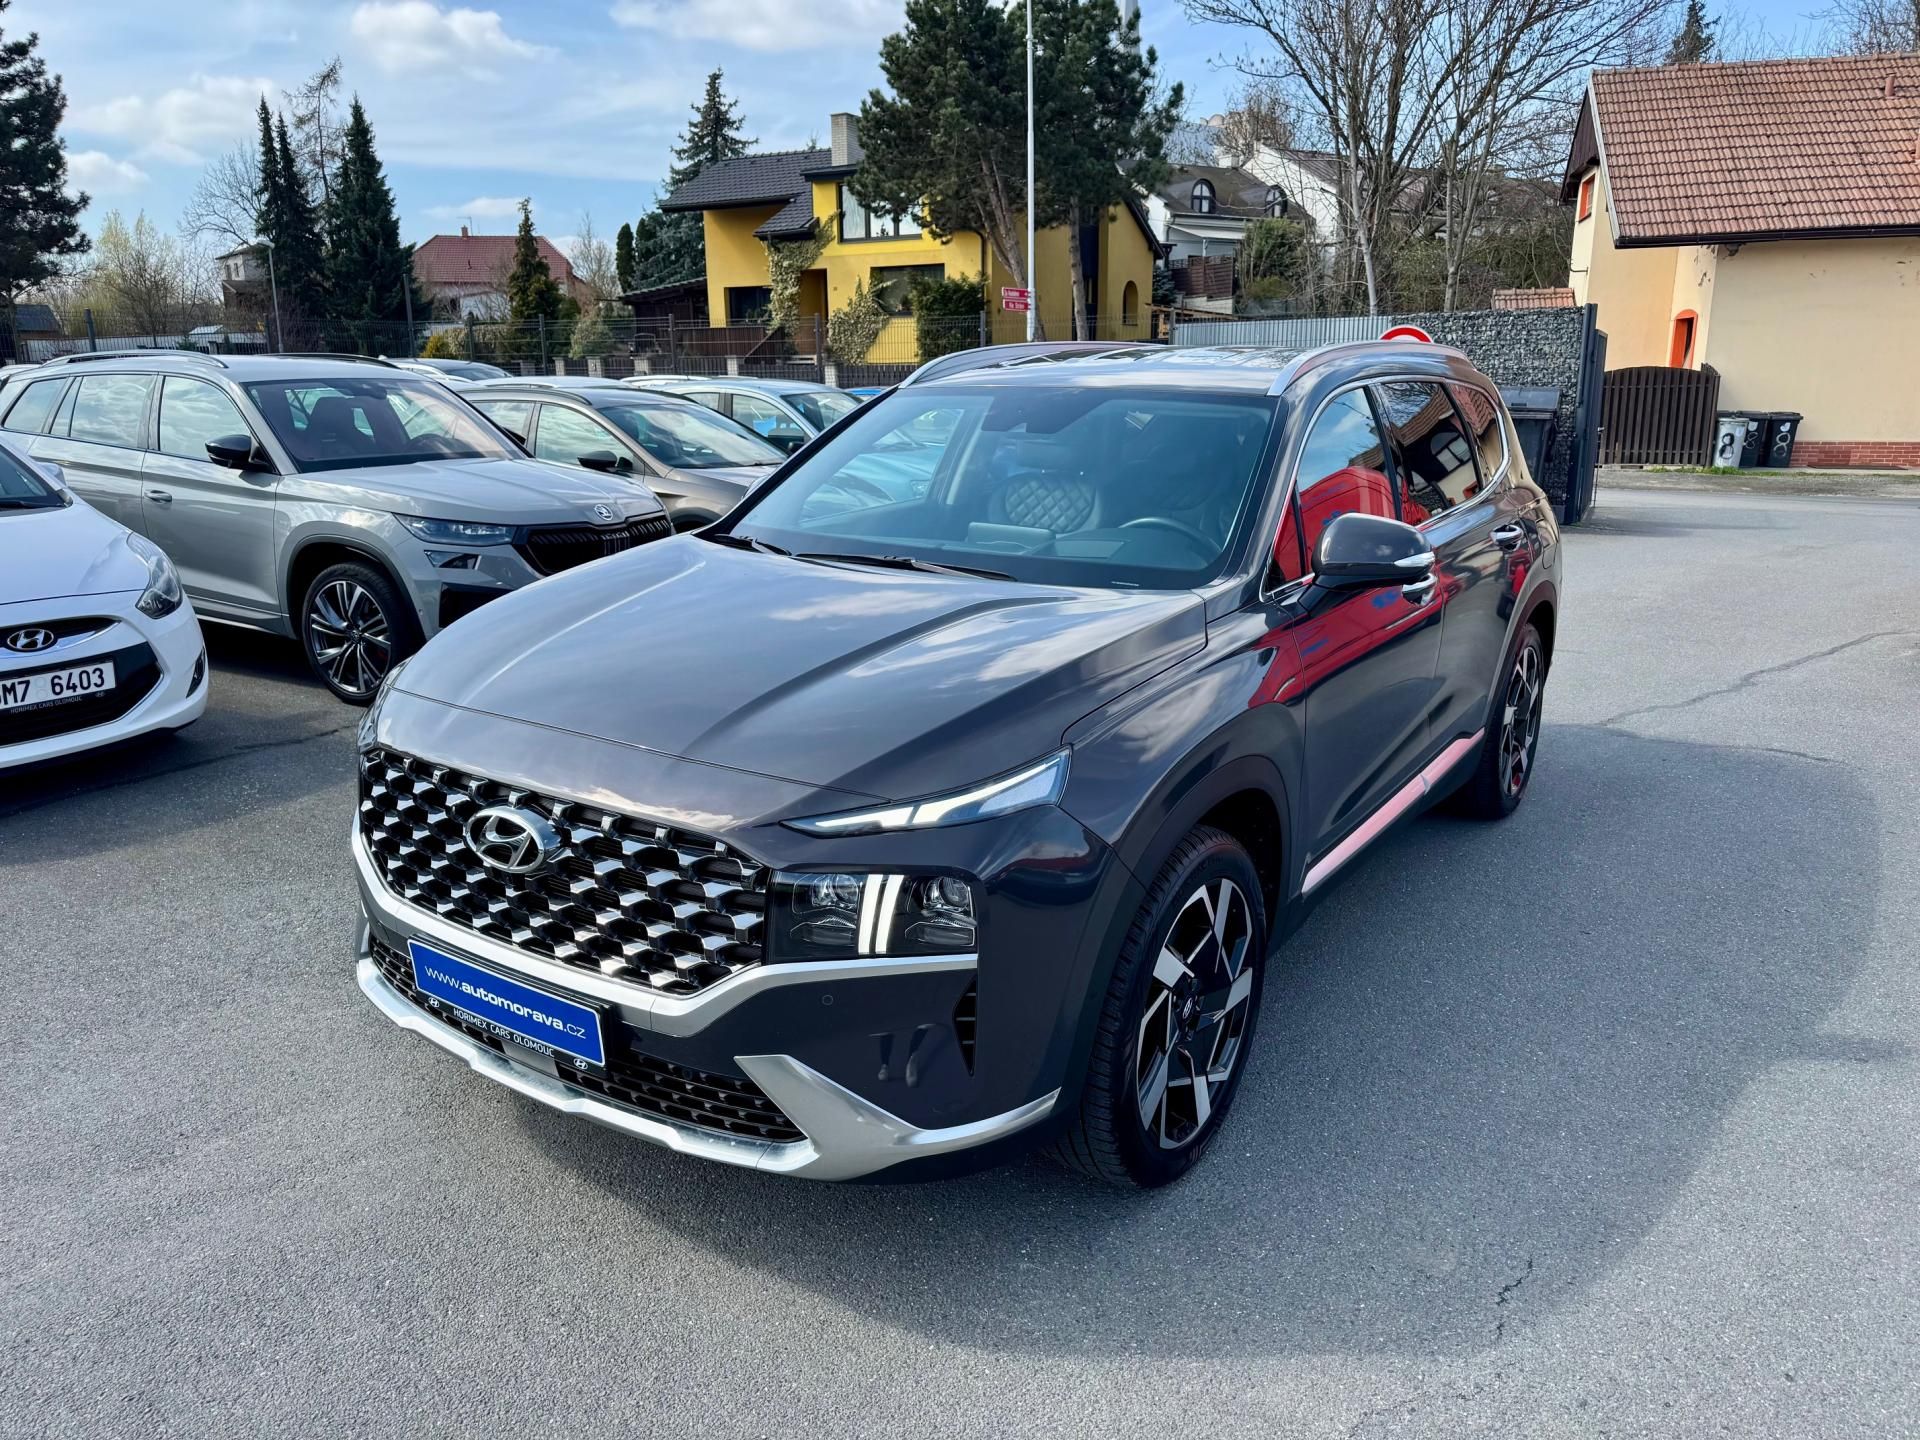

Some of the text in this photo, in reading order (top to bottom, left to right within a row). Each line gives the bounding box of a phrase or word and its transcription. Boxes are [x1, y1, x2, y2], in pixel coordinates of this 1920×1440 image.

[1719, 432, 1735, 460] 8
[1773, 432, 1791, 458] 8
[0, 667, 105, 705] M7 6403
[38, 701, 54, 709] CARS
[55, 696, 83, 706] OLOMOUC
[424, 965, 587, 1040] www.automorava.cz
[453, 1007, 555, 1058] HORIMEX CARS OLOMOUC
